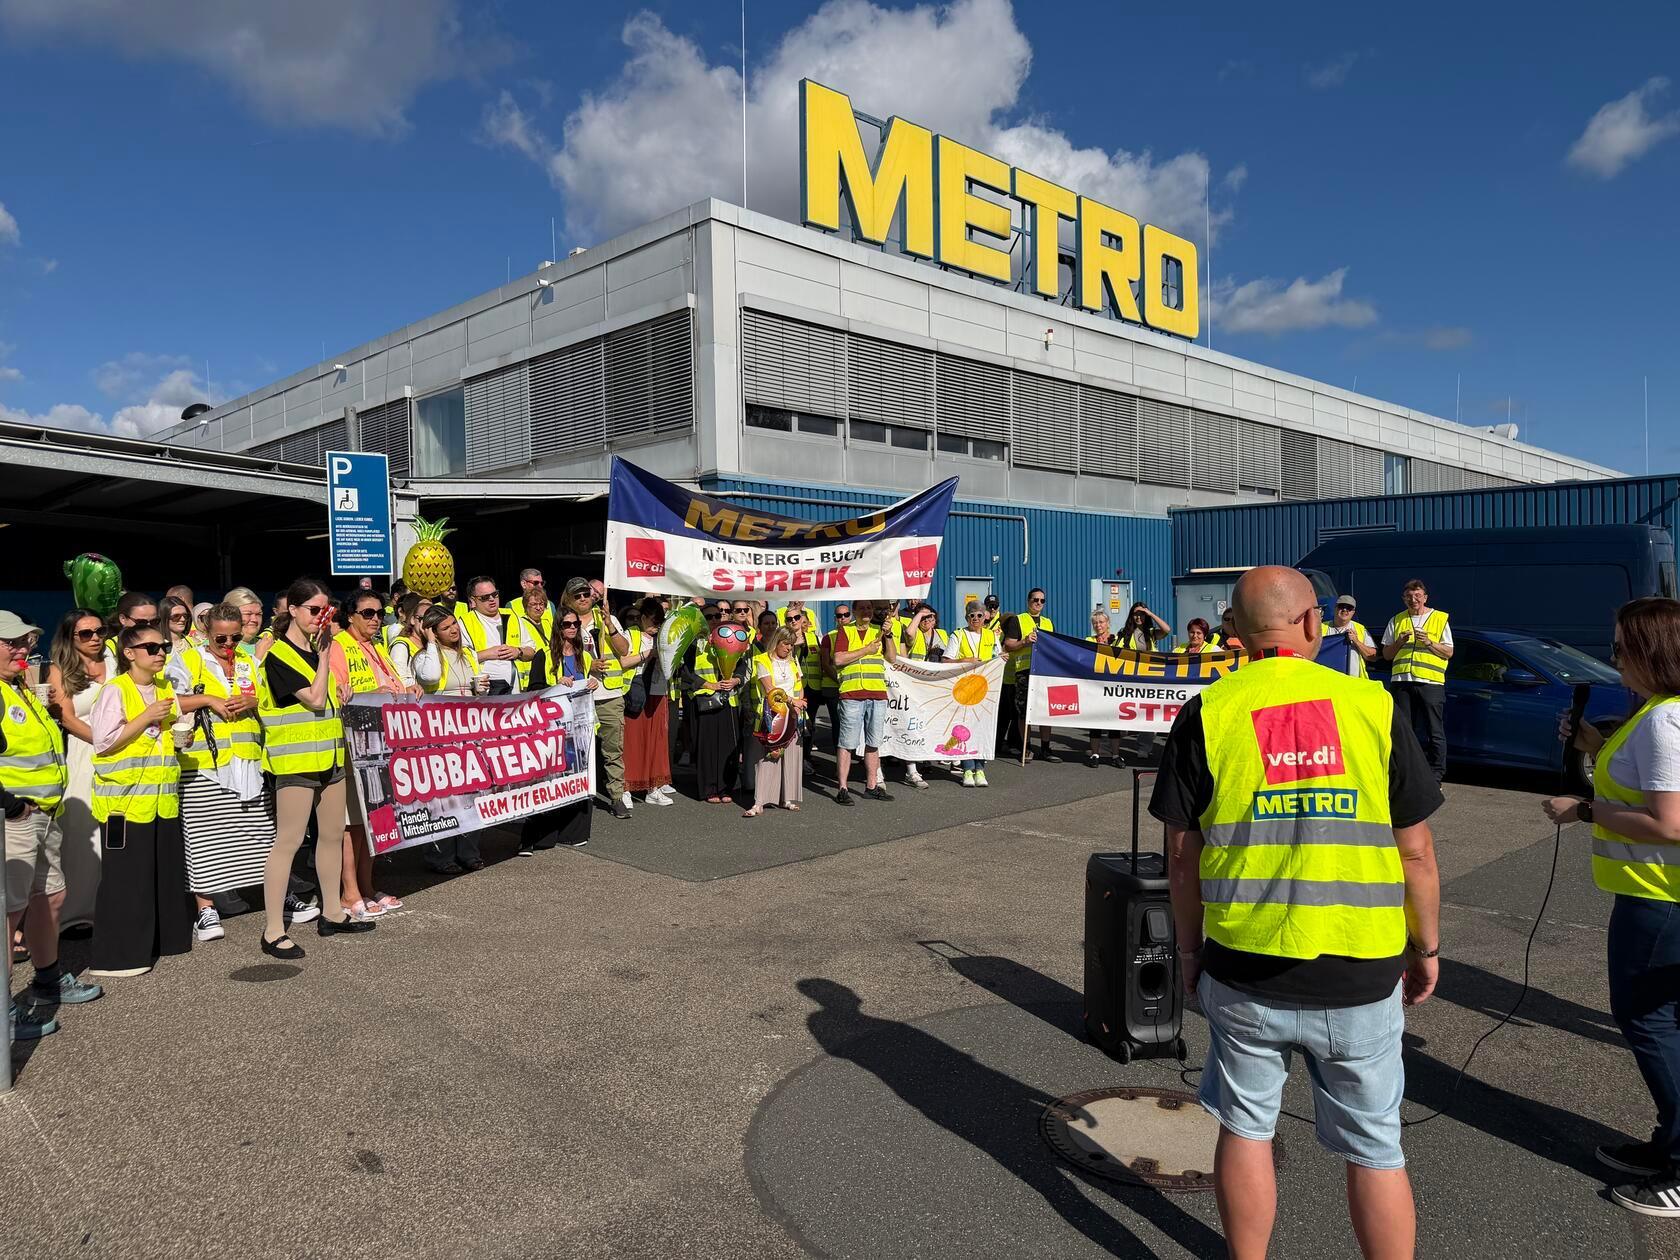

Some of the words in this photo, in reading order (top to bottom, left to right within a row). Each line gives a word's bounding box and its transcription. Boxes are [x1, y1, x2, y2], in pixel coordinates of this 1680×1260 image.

[800, 78, 1199, 338] METRO
[332, 457, 352, 484] P
[628, 559, 663, 574] ver.di
[702, 547, 799, 566] NÜRNBERG
[820, 547, 865, 564] BUCH
[712, 566, 851, 592] STREIK
[1103, 685, 1187, 700] NÜRNBERG
[1050, 701, 1078, 711] ver.di
[385, 709, 424, 740] MIR
[500, 701, 544, 730] ZAM
[907, 716, 924, 730] Eis
[393, 750, 487, 796] SUBBA
[485, 735, 564, 779] TEAM!
[1267, 746, 1336, 766] ver.di
[478, 797, 509, 818] H&M
[511, 793, 529, 812] 717
[532, 777, 589, 805] ERLANGEN
[1256, 792, 1354, 815] METRO
[401, 809, 429, 825] Handel
[403, 817, 458, 839] Mittelfranken
